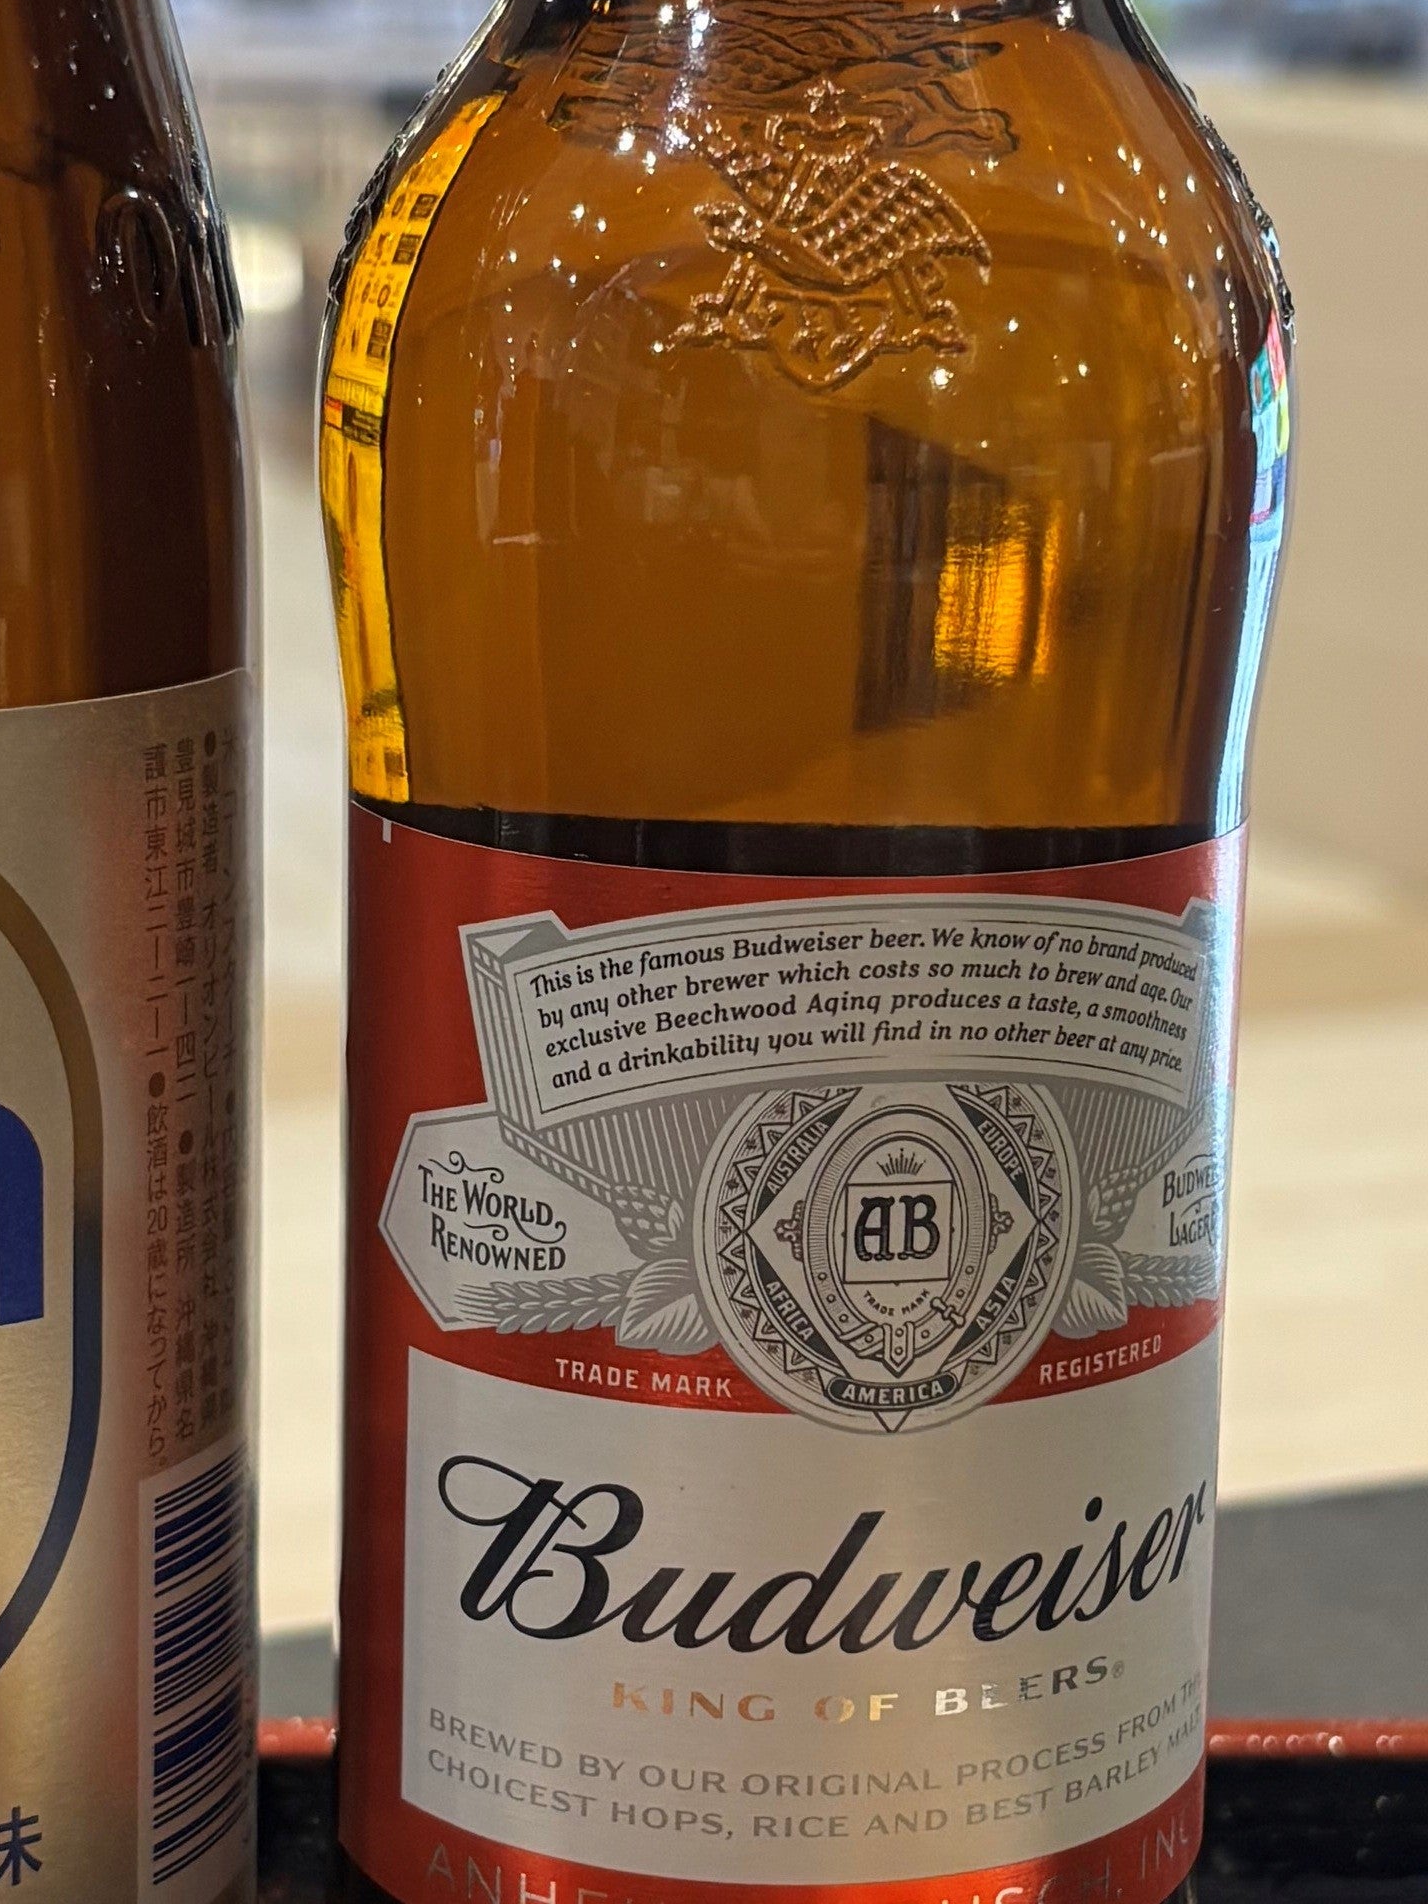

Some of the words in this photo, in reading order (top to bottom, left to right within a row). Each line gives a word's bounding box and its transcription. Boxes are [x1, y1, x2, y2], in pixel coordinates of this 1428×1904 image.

[530, 973, 573, 999] This
[577, 964, 595, 987] is
[599, 957, 634, 981] the
[639, 944, 725, 977] famous
[732, 931, 863, 960] Budweiser
[871, 928, 925, 950] beer.
[931, 927, 964, 948] We
[970, 927, 1031, 951] know
[1033, 930, 1060, 956] of
[1059, 936, 1084, 954] no
[1087, 936, 1138, 963] brand
[1138, 944, 1198, 983] produced
[538, 1007, 564, 1029] by
[570, 996, 610, 1020] any
[616, 983, 678, 1010] other
[685, 968, 770, 997] brewer
[777, 960, 850, 986] which
[858, 959, 920, 980] costs
[927, 962, 954, 979] so
[960, 959, 1022, 980] much
[1028, 961, 1050, 982] to
[1054, 961, 1103, 987] brew
[1105, 970, 1137, 995] and
[1139, 980, 1168, 1005] age.
[1170, 986, 1194, 1012] Our
[545, 1019, 648, 1058] exclusive
[655, 995, 797, 1034] Beechwood
[805, 991, 881, 1017] Aging
[888, 988, 1001, 1014] produces
[1007, 994, 1021, 1011] a
[1026, 991, 1082, 1019] taste,
[1086, 1001, 1100, 1018] a
[1101, 1002, 1188, 1042] smoothness
[552, 1060, 592, 1089] and
[597, 1059, 612, 1078] a
[618, 1033, 760, 1074] drinkability
[767, 1032, 814, 1054] you
[821, 1021, 865, 1045] will
[872, 1019, 922, 1046] find
[930, 1019, 952, 1041] in
[959, 1023, 988, 1042] no
[994, 1021, 1051, 1045] other
[1054, 1029, 1098, 1049] beer
[1098, 1034, 1117, 1053] at
[1119, 1039, 1150, 1065] any
[1149, 1043, 1183, 1073] price.
[766, 1119, 830, 1196] AUSTRALIA
[976, 1120, 1025, 1182] EUROPE
[1162, 1163, 1218, 1208] BUDWE
[854, 1193, 941, 1262] AB
[766, 1280, 816, 1342] AFRICA
[863, 1290, 895, 1317] TRADE
[901, 1289, 932, 1316] MARK
[975, 1275, 1019, 1332] ASIA
[554, 1357, 640, 1391] TRADE
[651, 1371, 734, 1399] MARK
[841, 1380, 945, 1405] AMERICA
[1039, 1334, 1164, 1386] REGISTERED
[437, 1454, 1208, 1655] Budweiser
[612, 1681, 776, 1722] KING
[814, 1693, 899, 1723] OF
[429, 1707, 563, 1770] BREWED
[578, 1753, 625, 1782] BY
[638, 1763, 727, 1795] OUR
[741, 1768, 941, 1798] ORIGINAL
[956, 1731, 1105, 1787] PROCESS
[1117, 1694, 1176, 1745] FROM
[428, 1747, 598, 1818] CHOICEST
[610, 1800, 734, 1840] HOPS,
[752, 1814, 850, 1838] RICE
[864, 1808, 948, 1837] AND
[965, 1786, 1058, 1827] BEST
[1064, 1744, 1161, 1804] BARLEY
